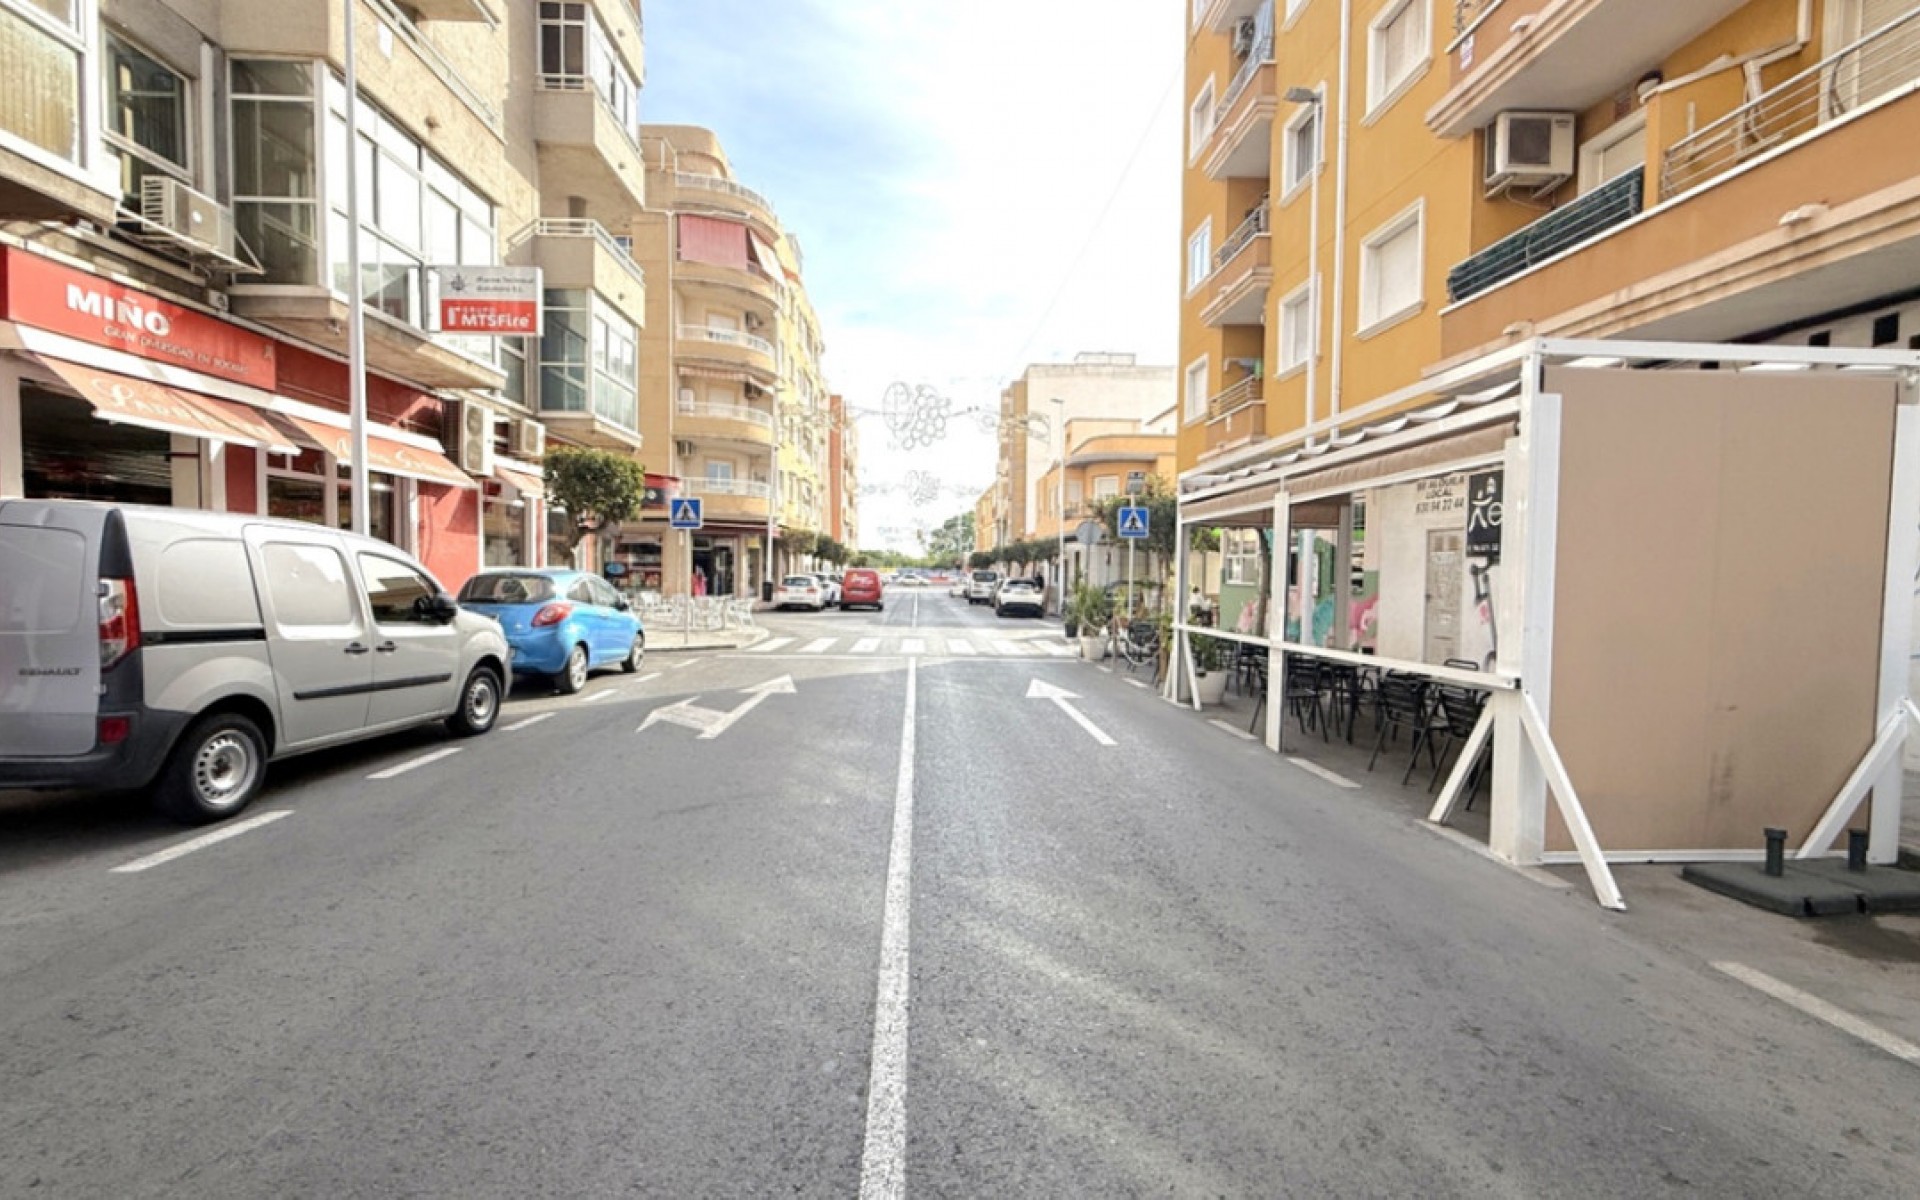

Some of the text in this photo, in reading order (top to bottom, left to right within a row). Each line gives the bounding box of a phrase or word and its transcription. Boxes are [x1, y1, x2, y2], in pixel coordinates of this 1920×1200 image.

[66, 283, 171, 337] MIÑO
[103, 325, 137, 343] GRAN
[1425, 487, 1453, 499] LOCAL
[19, 667, 81, 677] RENAULT
